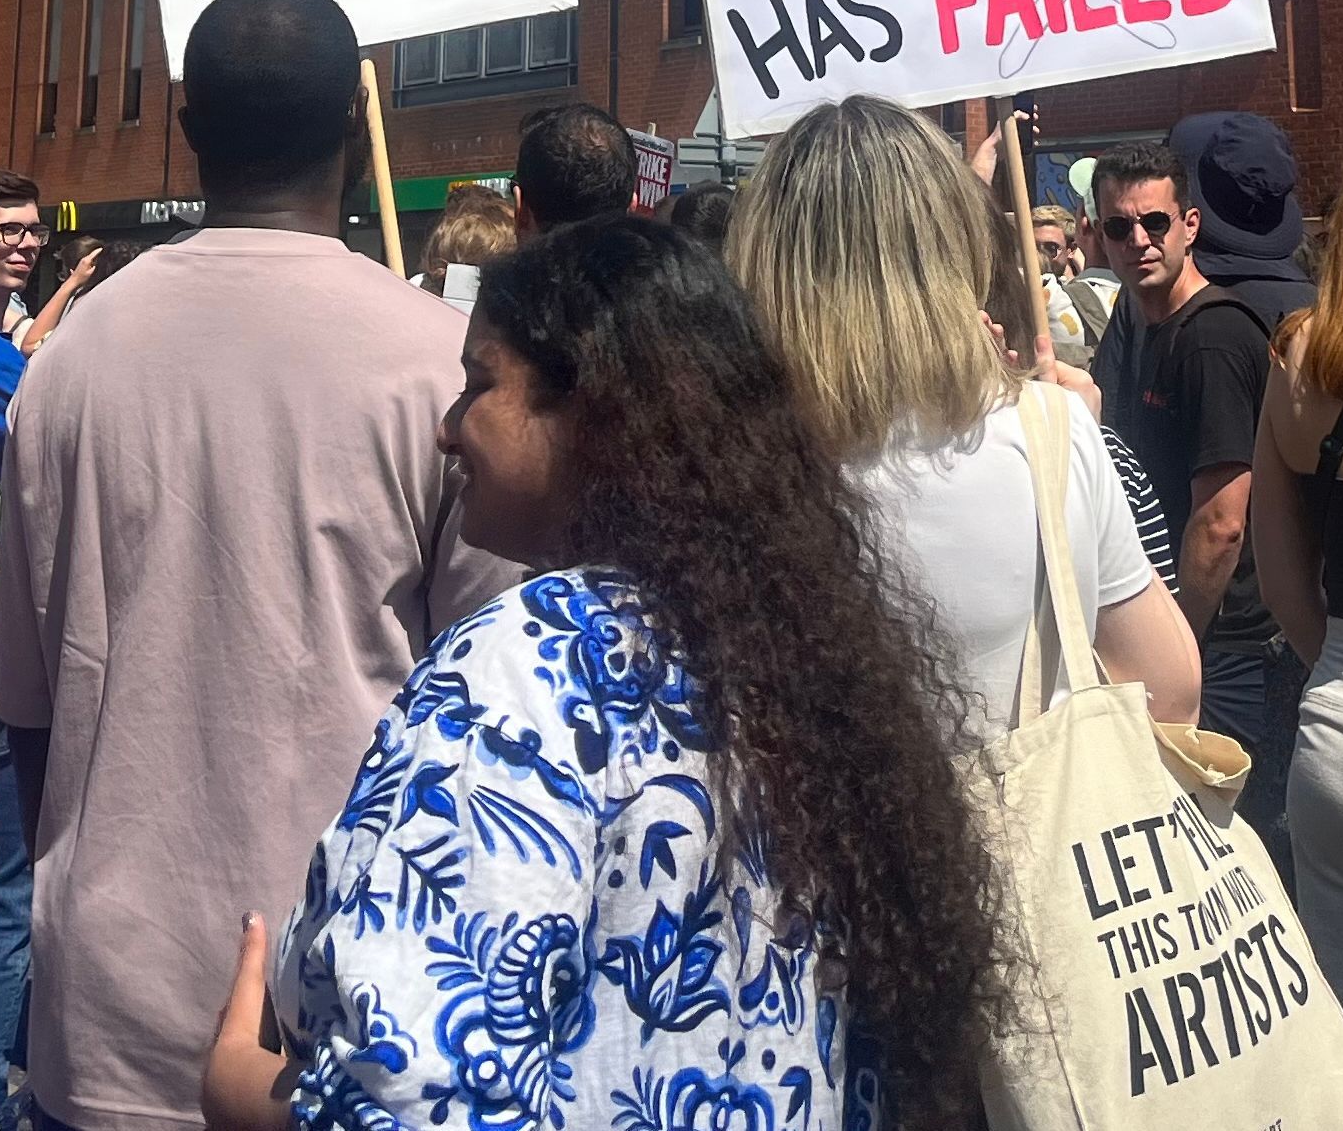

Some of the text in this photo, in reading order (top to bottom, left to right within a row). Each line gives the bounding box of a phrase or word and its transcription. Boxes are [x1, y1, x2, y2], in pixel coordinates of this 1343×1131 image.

[636, 150, 668, 184] RIKE
[1097, 913, 1178, 979] THIS
[1125, 914, 1308, 1098] ARTISTS
